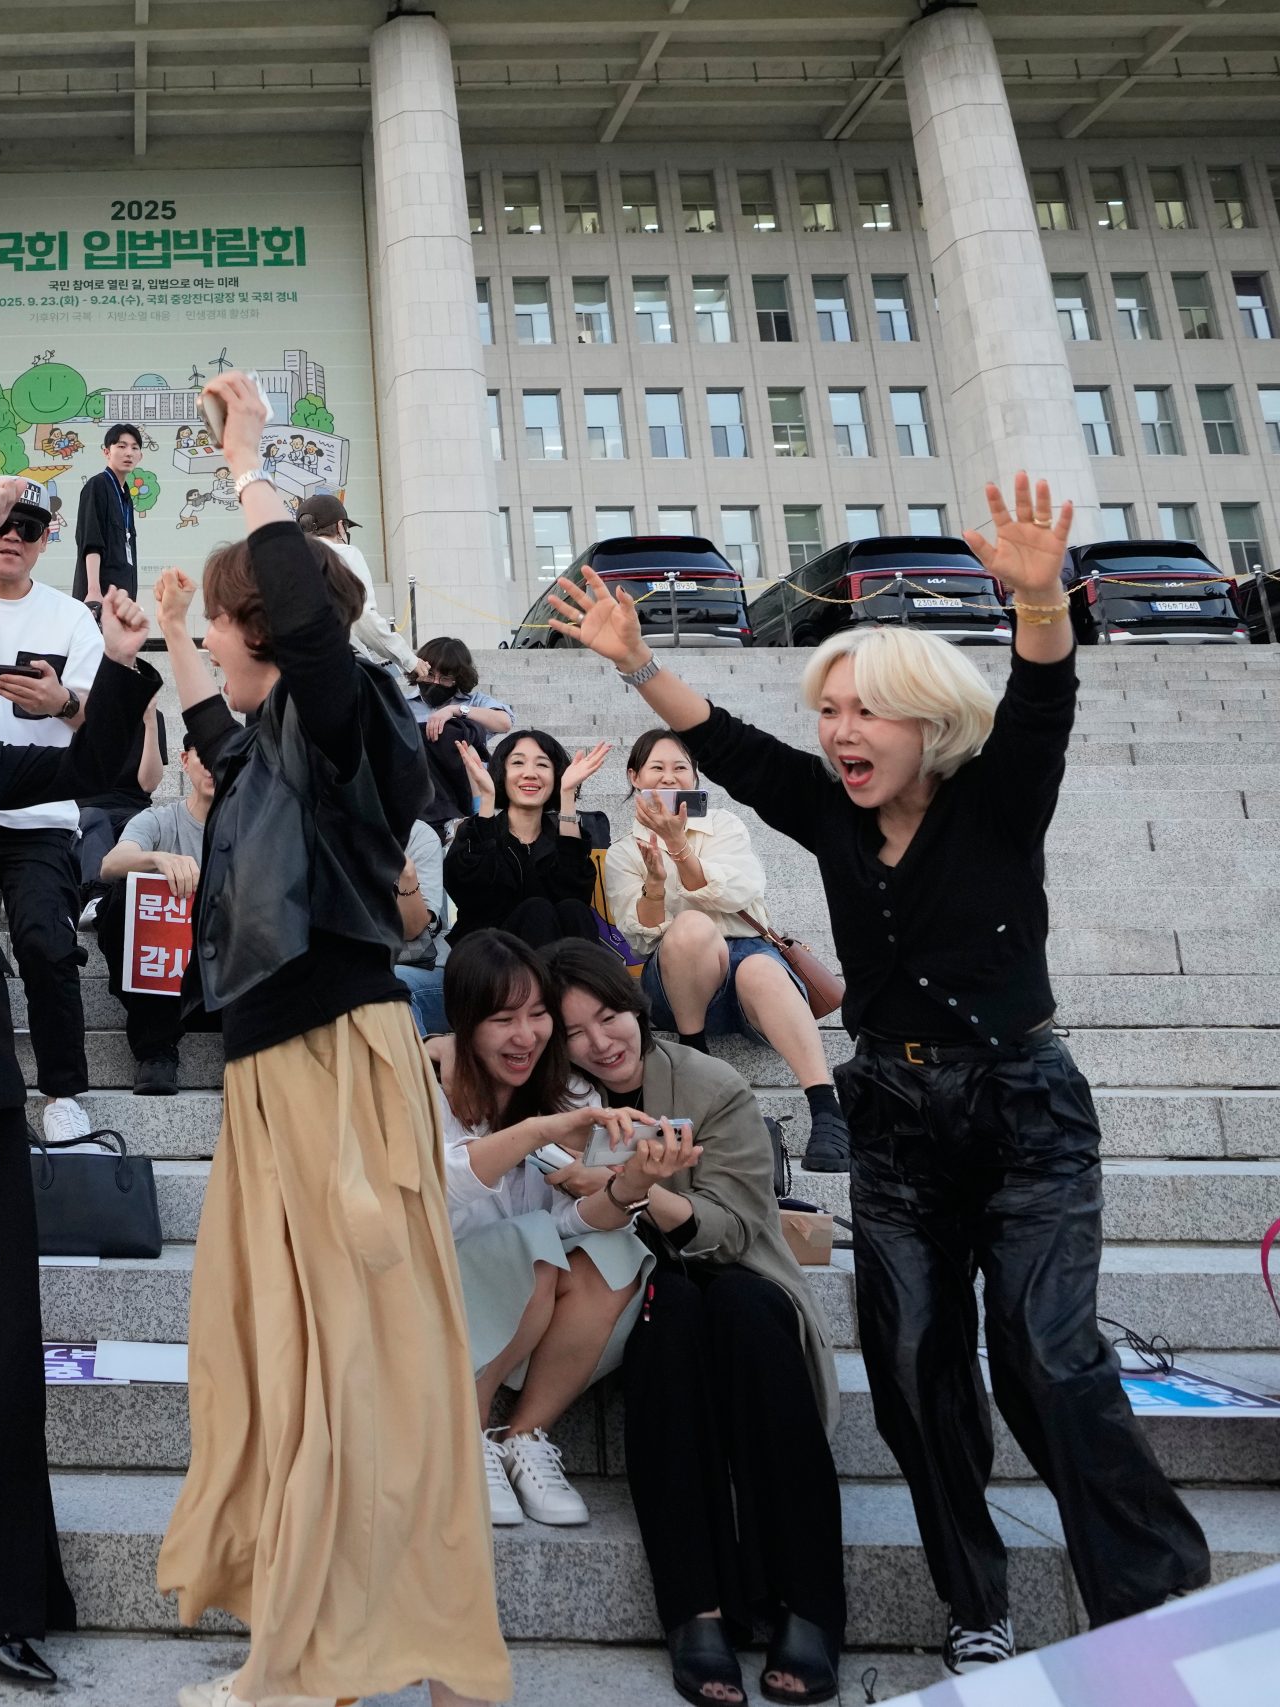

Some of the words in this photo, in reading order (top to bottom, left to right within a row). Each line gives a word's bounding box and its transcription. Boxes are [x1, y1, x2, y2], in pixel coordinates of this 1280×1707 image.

[111, 200, 177, 221] 2025
[83, 226, 307, 271] 입법박람회
[48, 280, 70, 291] 국민
[72, 279, 105, 291] 참여로
[106, 279, 129, 291] 열린
[131, 279, 145, 291] 길,
[147, 278, 191, 290] 입법으로
[193, 277, 215, 289] 여는
[217, 276, 239, 288] 미래
[146, 293, 168, 306] 국회
[170, 292, 236, 305] 중앙잔디광장
[238, 292, 249, 303] 및
[251, 291, 273, 303] 국회
[275, 291, 298, 303] 경내
[139, 893, 192, 924] 문신
